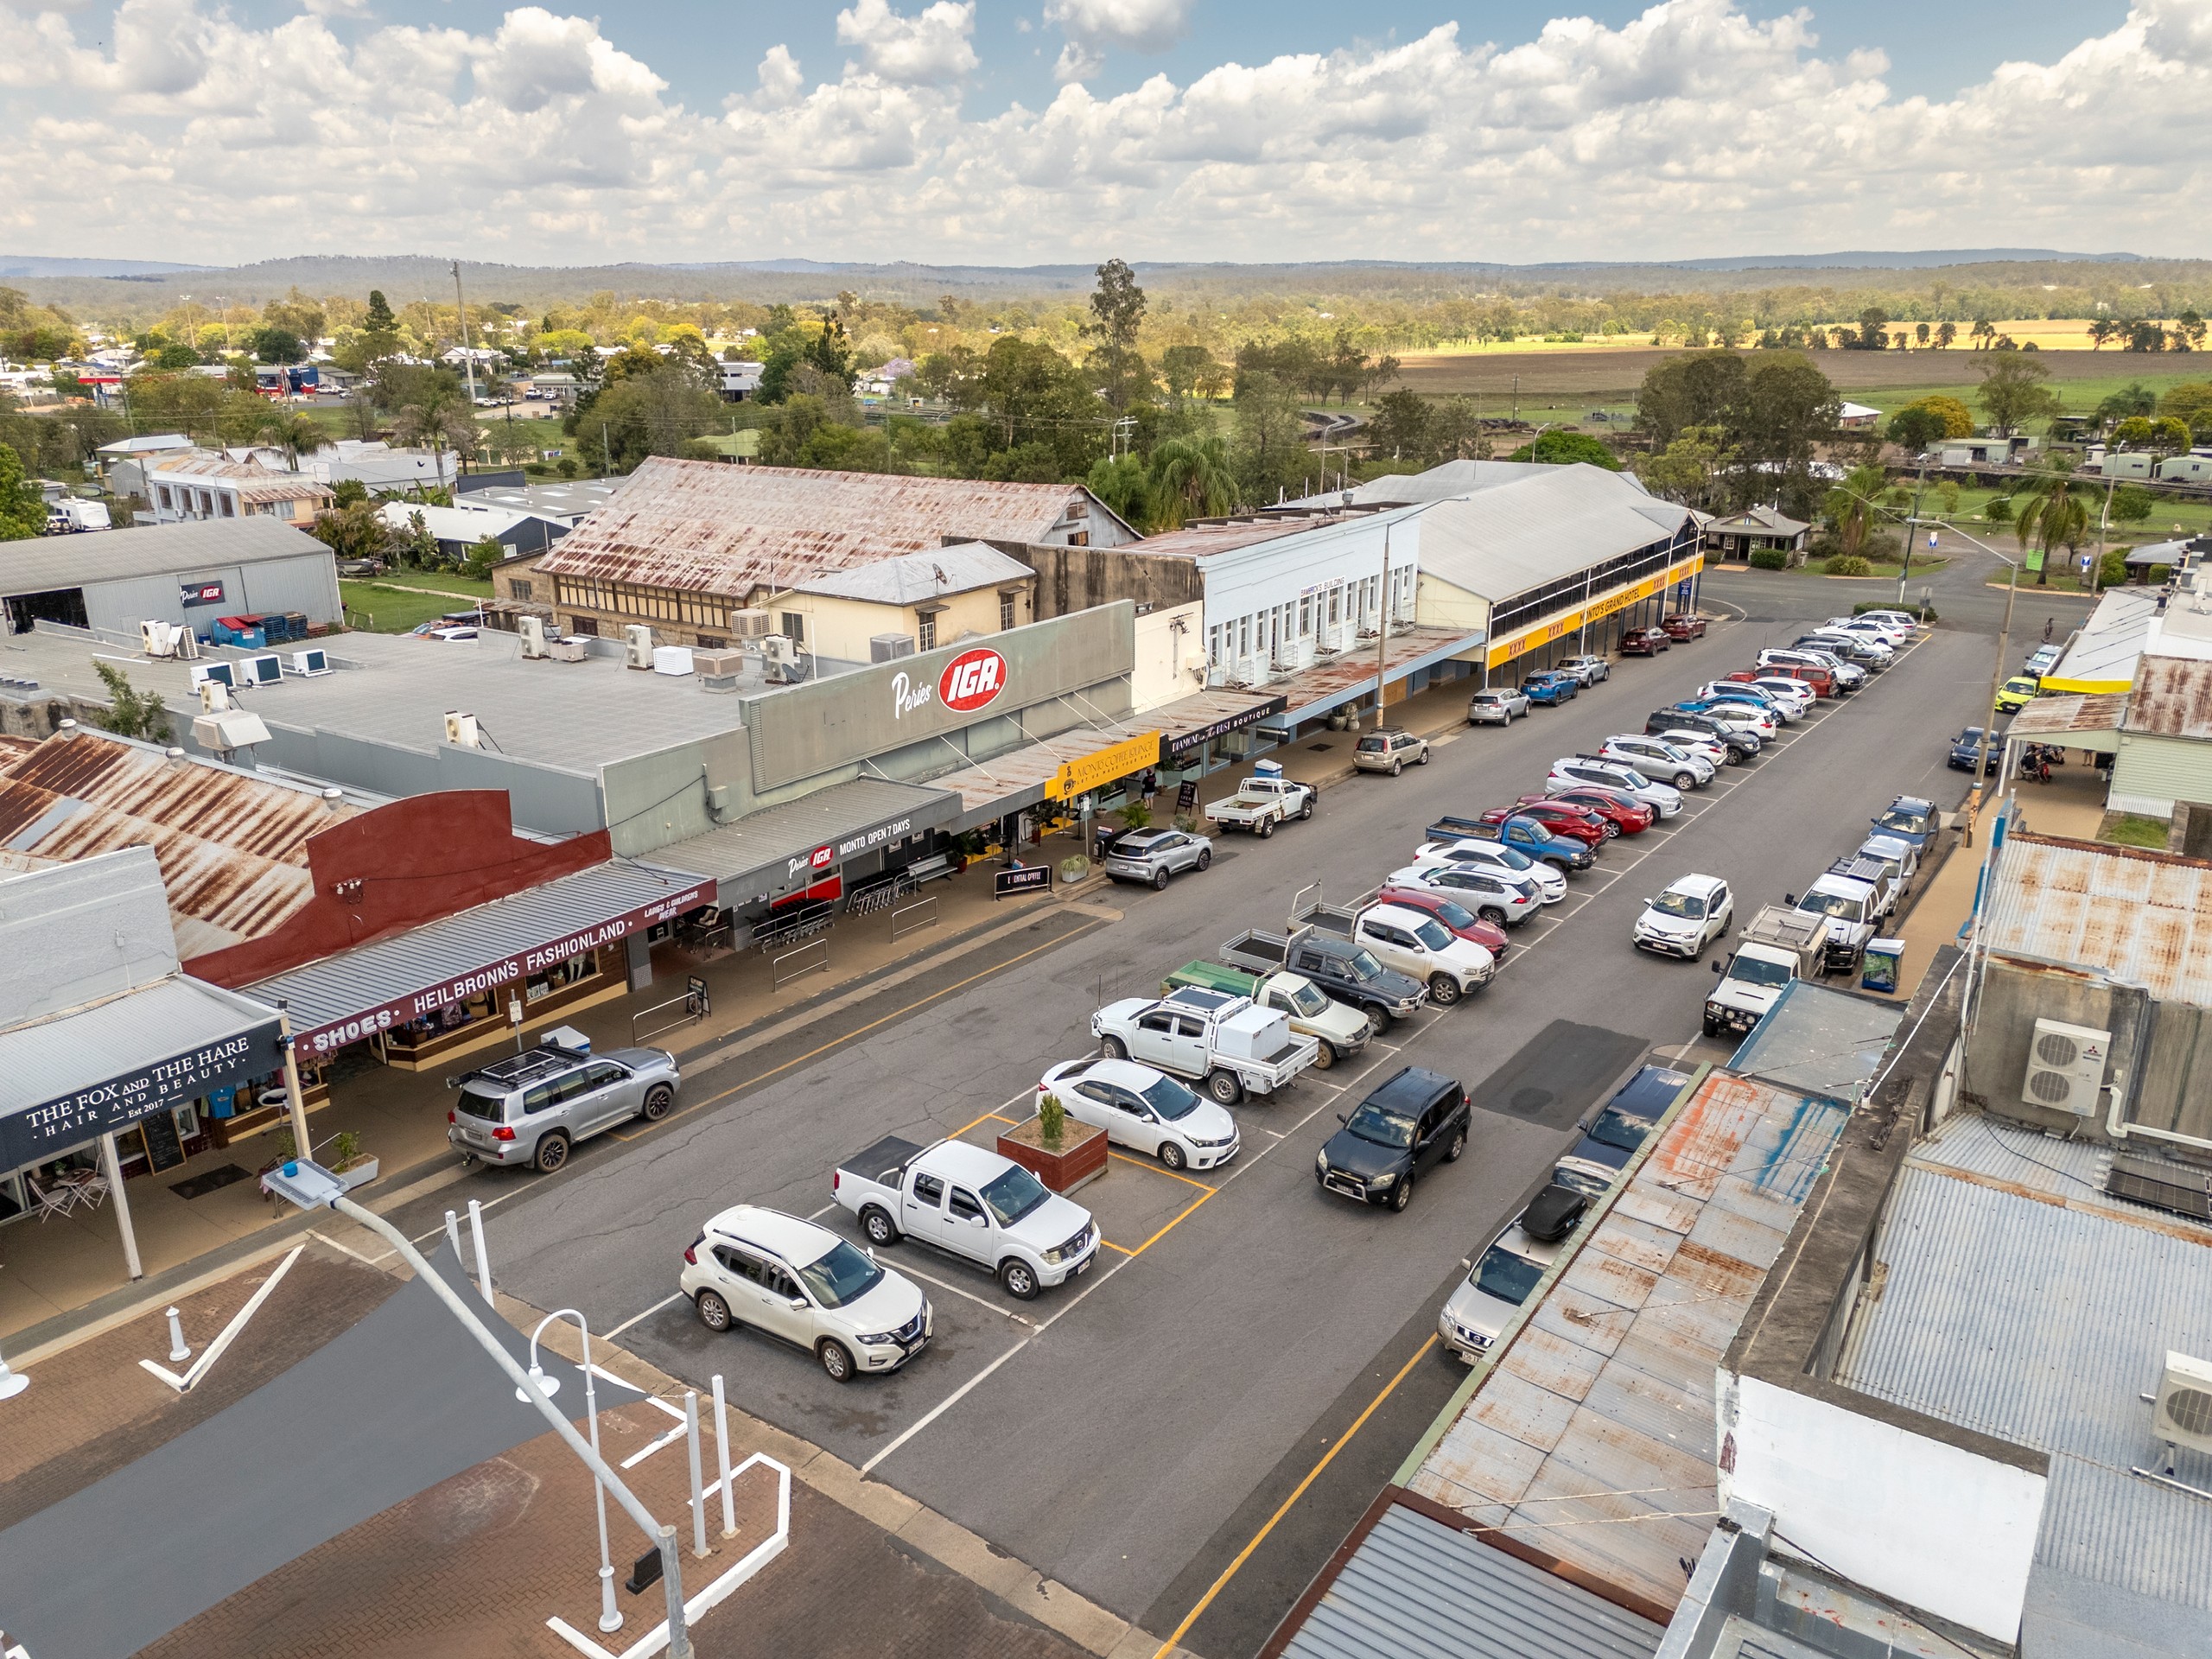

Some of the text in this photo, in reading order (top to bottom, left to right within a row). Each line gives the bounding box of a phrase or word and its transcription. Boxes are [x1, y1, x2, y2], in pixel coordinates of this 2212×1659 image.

[1678, 565, 1690, 577] XXXX
[1324, 576, 1344, 589] BUILDING
[1653, 575, 1665, 591] XXXX
[202, 588, 219, 599] IGA
[1605, 594, 1624, 611] GRAND
[1624, 588, 1640, 603] HOTEL
[1548, 621, 1565, 639] XXXX
[1508, 638, 1527, 657] XXXX
[892, 656, 999, 720] Peries IGA
[1172, 733, 1200, 753] DIAMOND
[1216, 721, 1230, 734] DUST
[1233, 707, 1270, 728] BOUTIQUE
[1077, 741, 1154, 778] MONTO COFFEE LOUNGE
[788, 818, 910, 880] Peries IGA MONTO OPEN 7 DAYS
[644, 904, 664, 918] LADIES
[658, 906, 677, 921] WEAR
[414, 920, 626, 1014] HEILBRONN'S FASHIONLAND
[313, 1009, 391, 1052] SHOES
[27, 1037, 250, 1128] THE FOX AND THE HARE
[45, 1057, 238, 1138] HAIR AND BEAUTY
[128, 1099, 164, 1119] Est 2017
